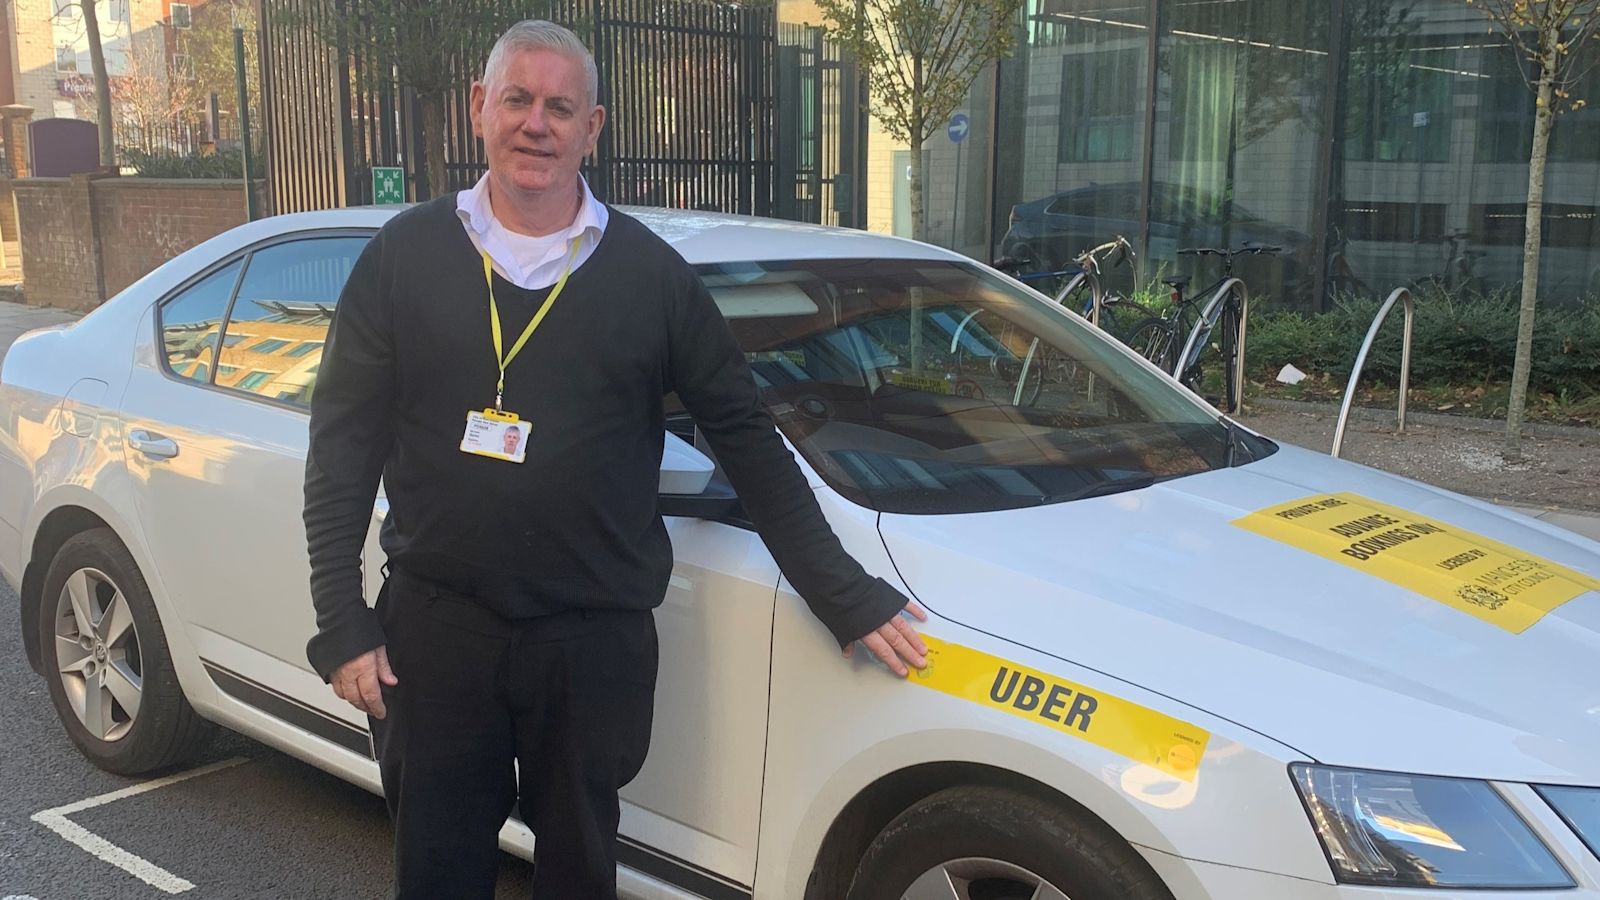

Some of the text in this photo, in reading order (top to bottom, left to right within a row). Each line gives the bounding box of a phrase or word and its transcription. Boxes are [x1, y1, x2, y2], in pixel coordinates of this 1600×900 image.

[1275, 498, 1348, 520] PRIVATE HIRE
[1329, 514, 1400, 538] ADVANCE
[1340, 523, 1447, 561] BOOKINGS ONLY
[1435, 552, 1479, 571] LICENSED
[990, 666, 1098, 733] UBER
